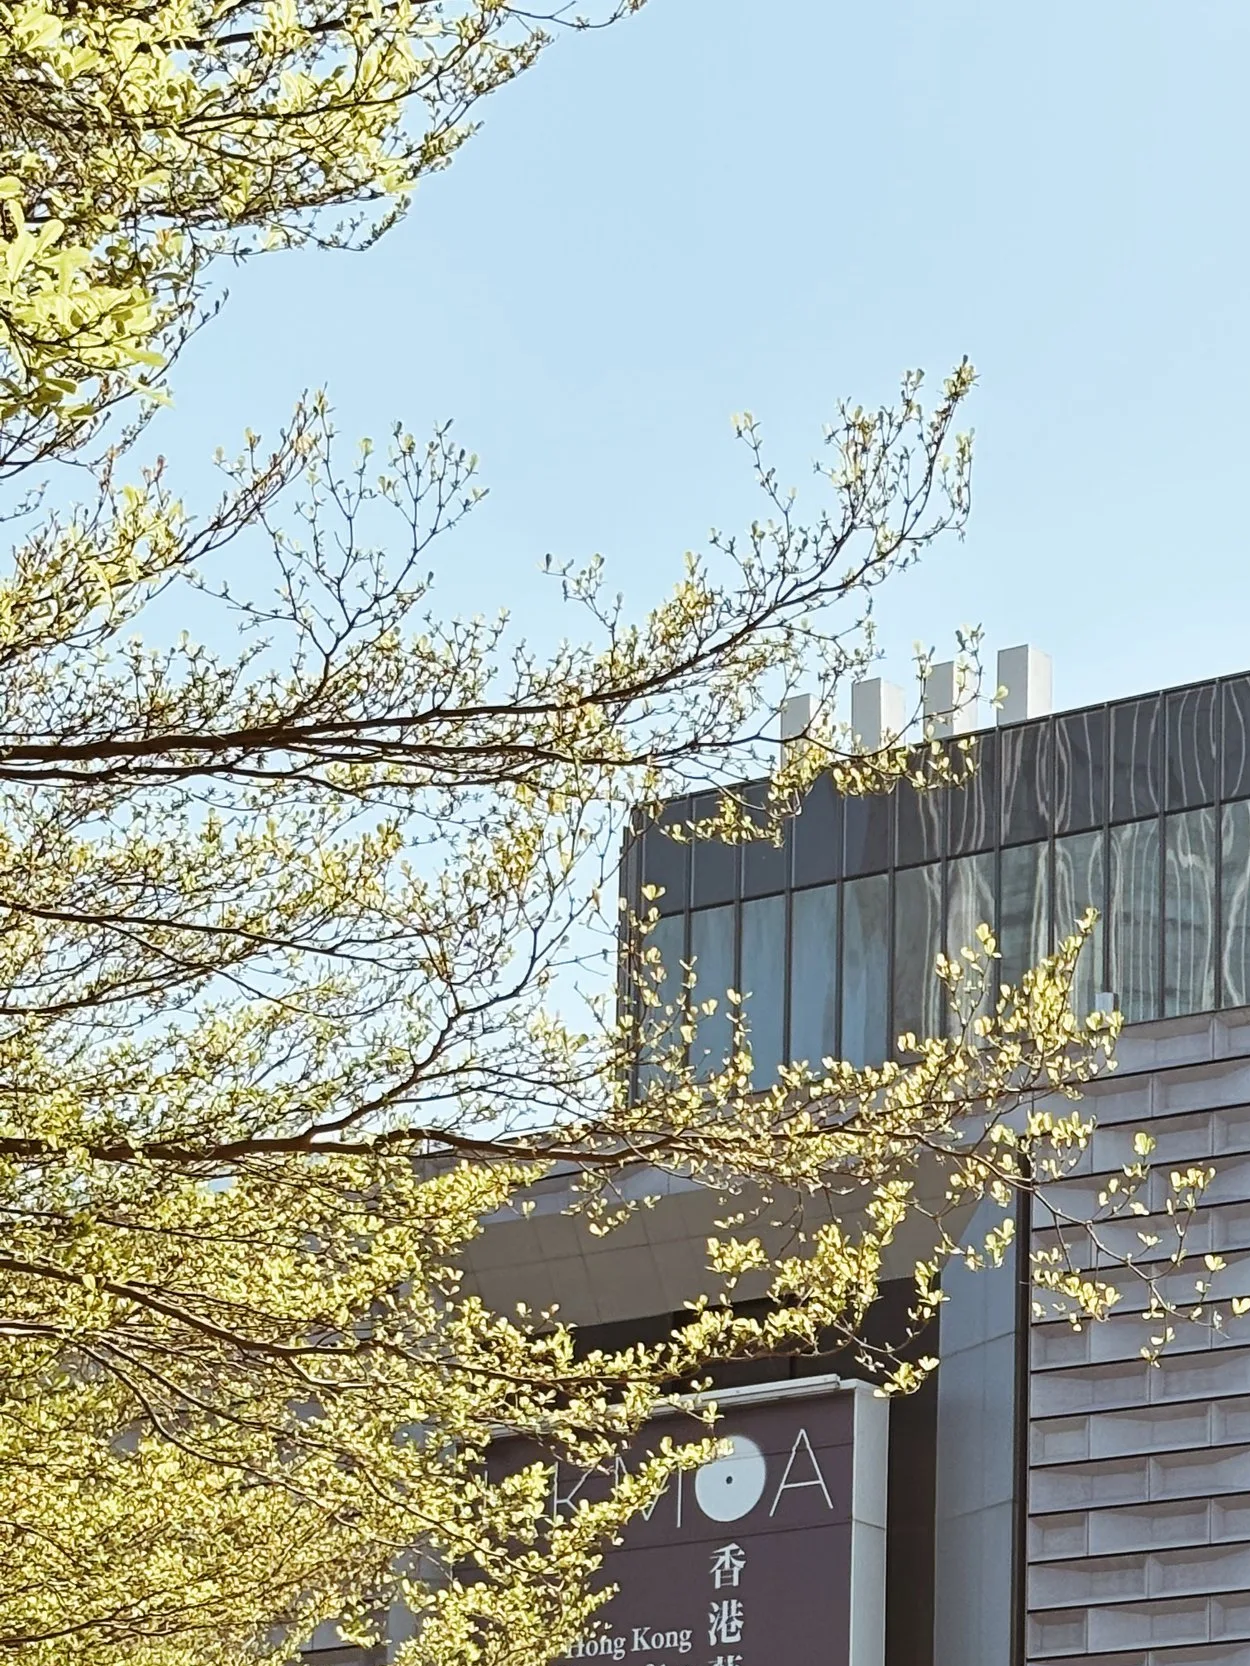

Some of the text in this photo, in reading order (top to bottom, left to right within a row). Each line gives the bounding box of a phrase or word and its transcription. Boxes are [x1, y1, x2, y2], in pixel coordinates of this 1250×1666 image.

[483, 1428, 834, 1532] KMOA
[564, 1626, 693, 1661] Hong Kong
